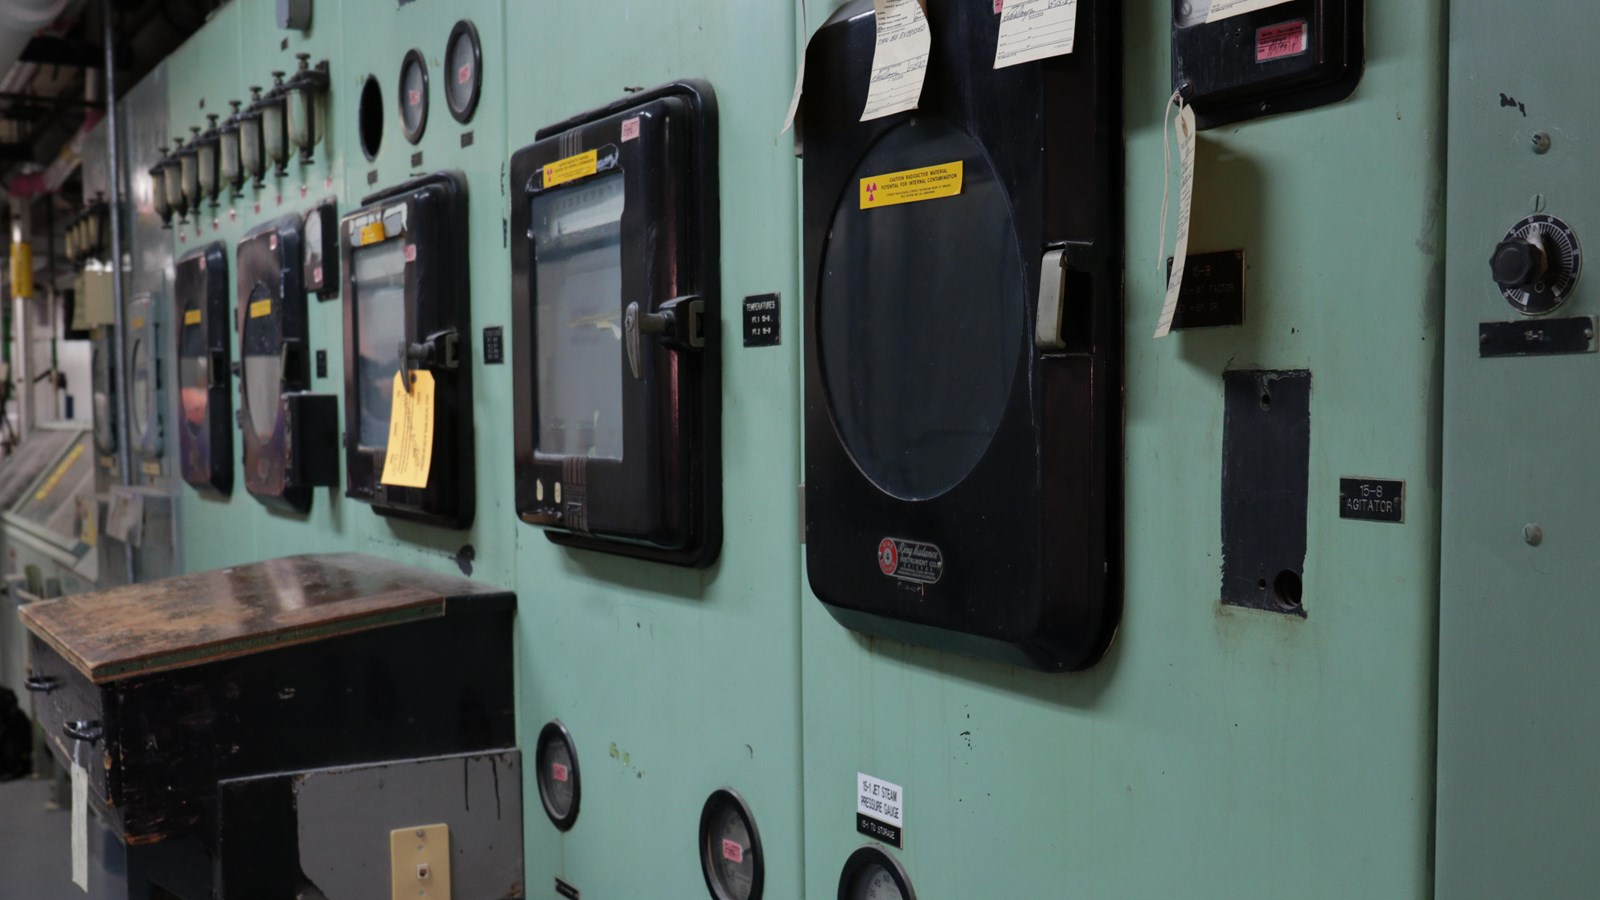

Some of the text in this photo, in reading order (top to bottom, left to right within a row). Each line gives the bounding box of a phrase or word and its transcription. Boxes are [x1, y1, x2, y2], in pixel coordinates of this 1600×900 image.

[889, 168, 948, 183] CAUTION RADIOACTIVE MATERIAL
[908, 178, 926, 186] INTERNAL
[927, 173, 958, 183] CONTAMINATION
[745, 300, 776, 311] TEMPERATURES
[1359, 485, 1383, 497] 15-8
[1347, 498, 1393, 512] AGITATOR
[898, 542, 912, 559] Ring
[913, 545, 939, 560] Balance
[899, 556, 928, 567] INSTRUMENT
[872, 783, 881, 796] JET
[881, 786, 898, 802] STEAM
[861, 795, 899, 819] PRESSURE GAUGE
[877, 825, 895, 840] STORAGE
